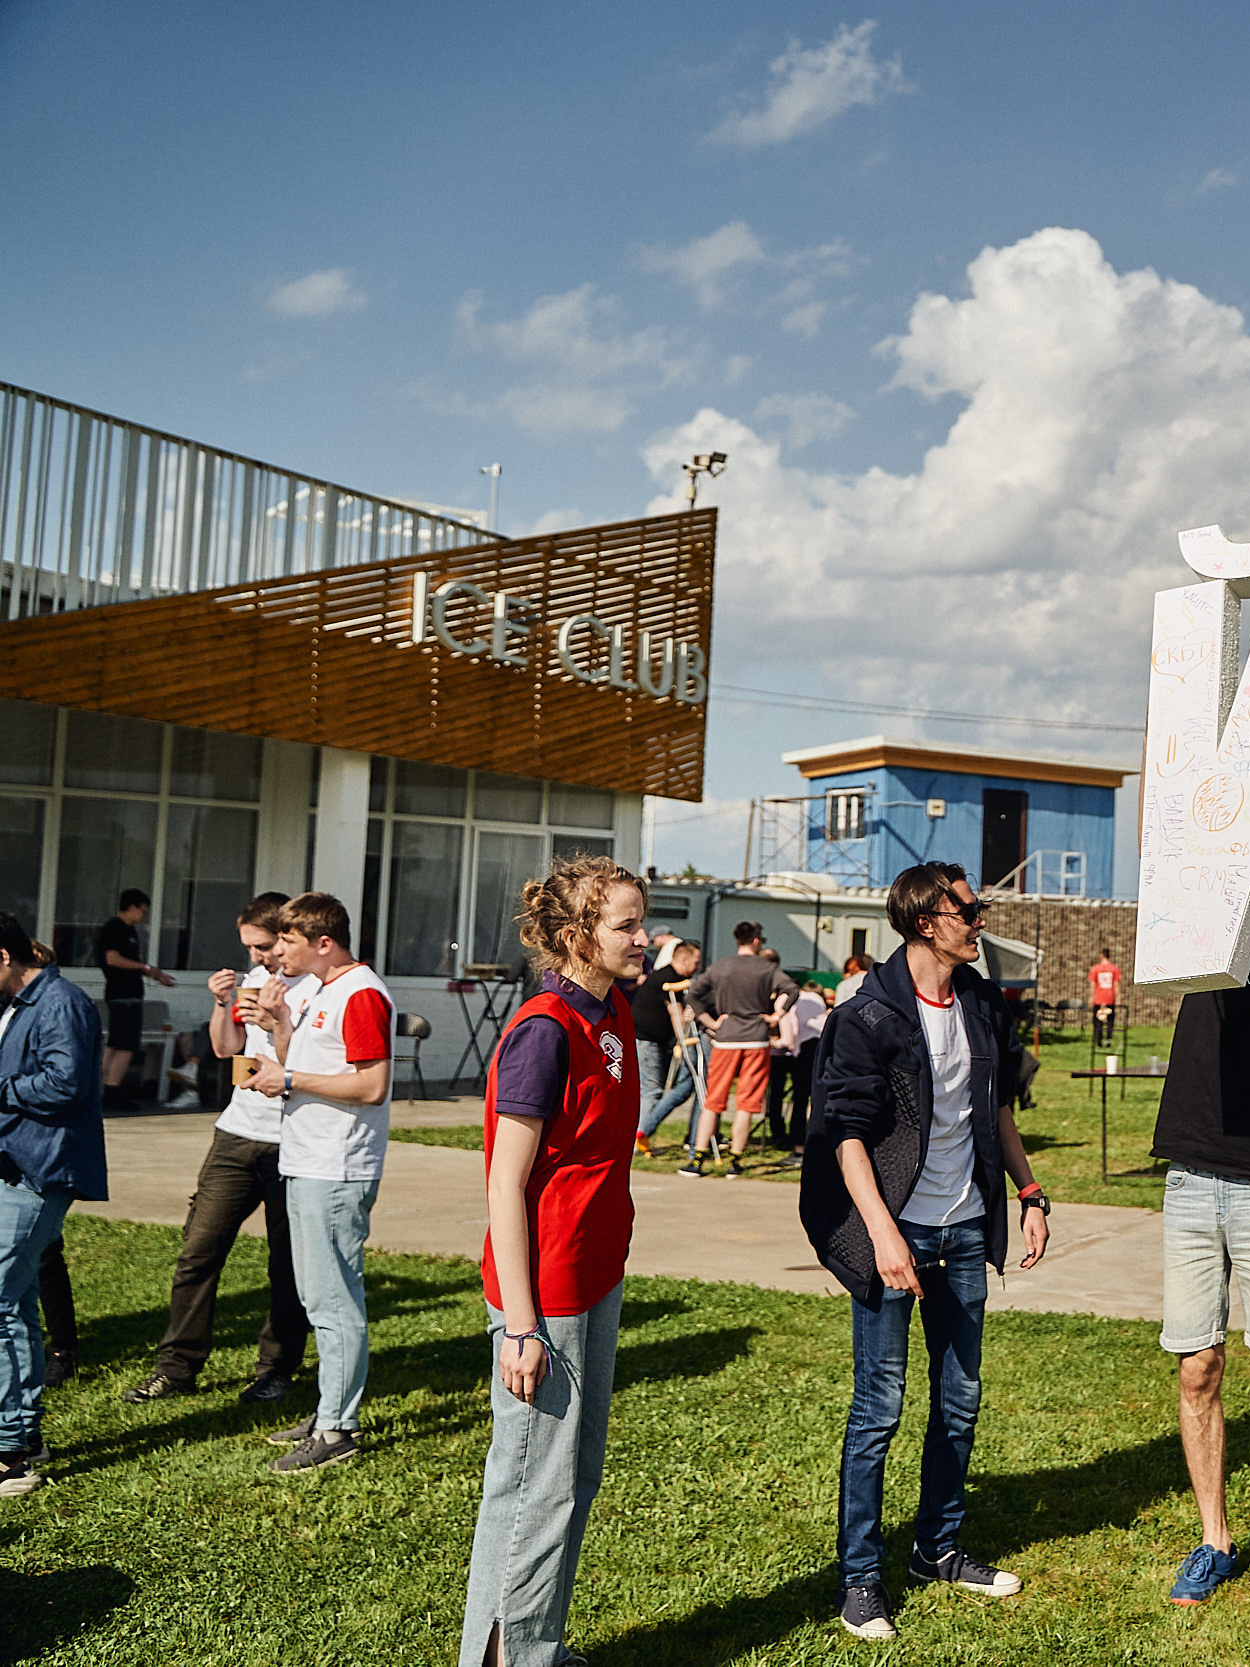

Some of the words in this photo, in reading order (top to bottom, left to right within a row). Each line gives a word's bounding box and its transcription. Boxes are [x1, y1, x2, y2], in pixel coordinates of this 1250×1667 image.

[412, 571, 531, 665] ICE
[558, 613, 707, 703] CLUB
[1179, 866, 1228, 897] CRM
